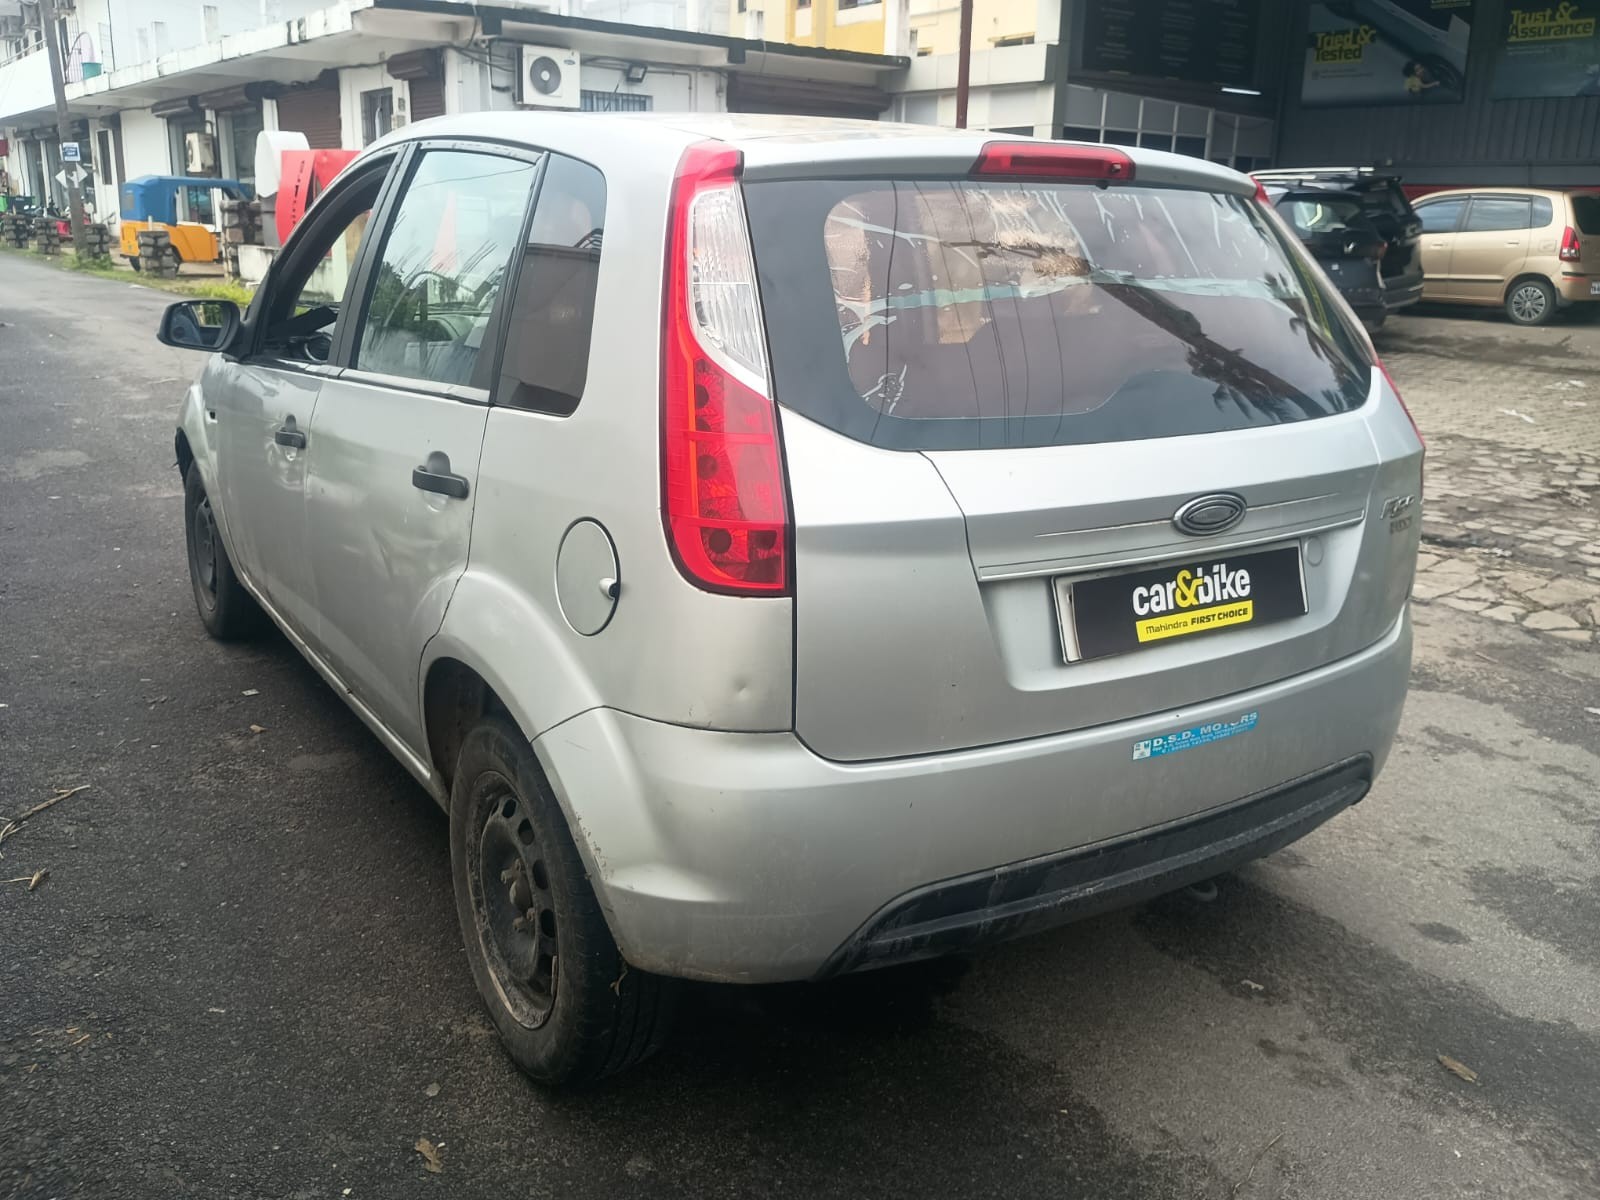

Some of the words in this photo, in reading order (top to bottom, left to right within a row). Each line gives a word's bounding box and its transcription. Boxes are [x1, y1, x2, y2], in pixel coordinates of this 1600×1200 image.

[1511, 9, 1552, 27] Trust
[1556, 1, 1579, 21] &
[1315, 31, 1351, 50] Tried
[1508, 18, 1593, 40] Assurance
[1314, 47, 1363, 62] Tested
[1132, 563, 1251, 615] car&bike
[1146, 621, 1188, 634] Mahindra
[1190, 614, 1216, 626] FIRST
[1217, 607, 1249, 621] CHOICE
